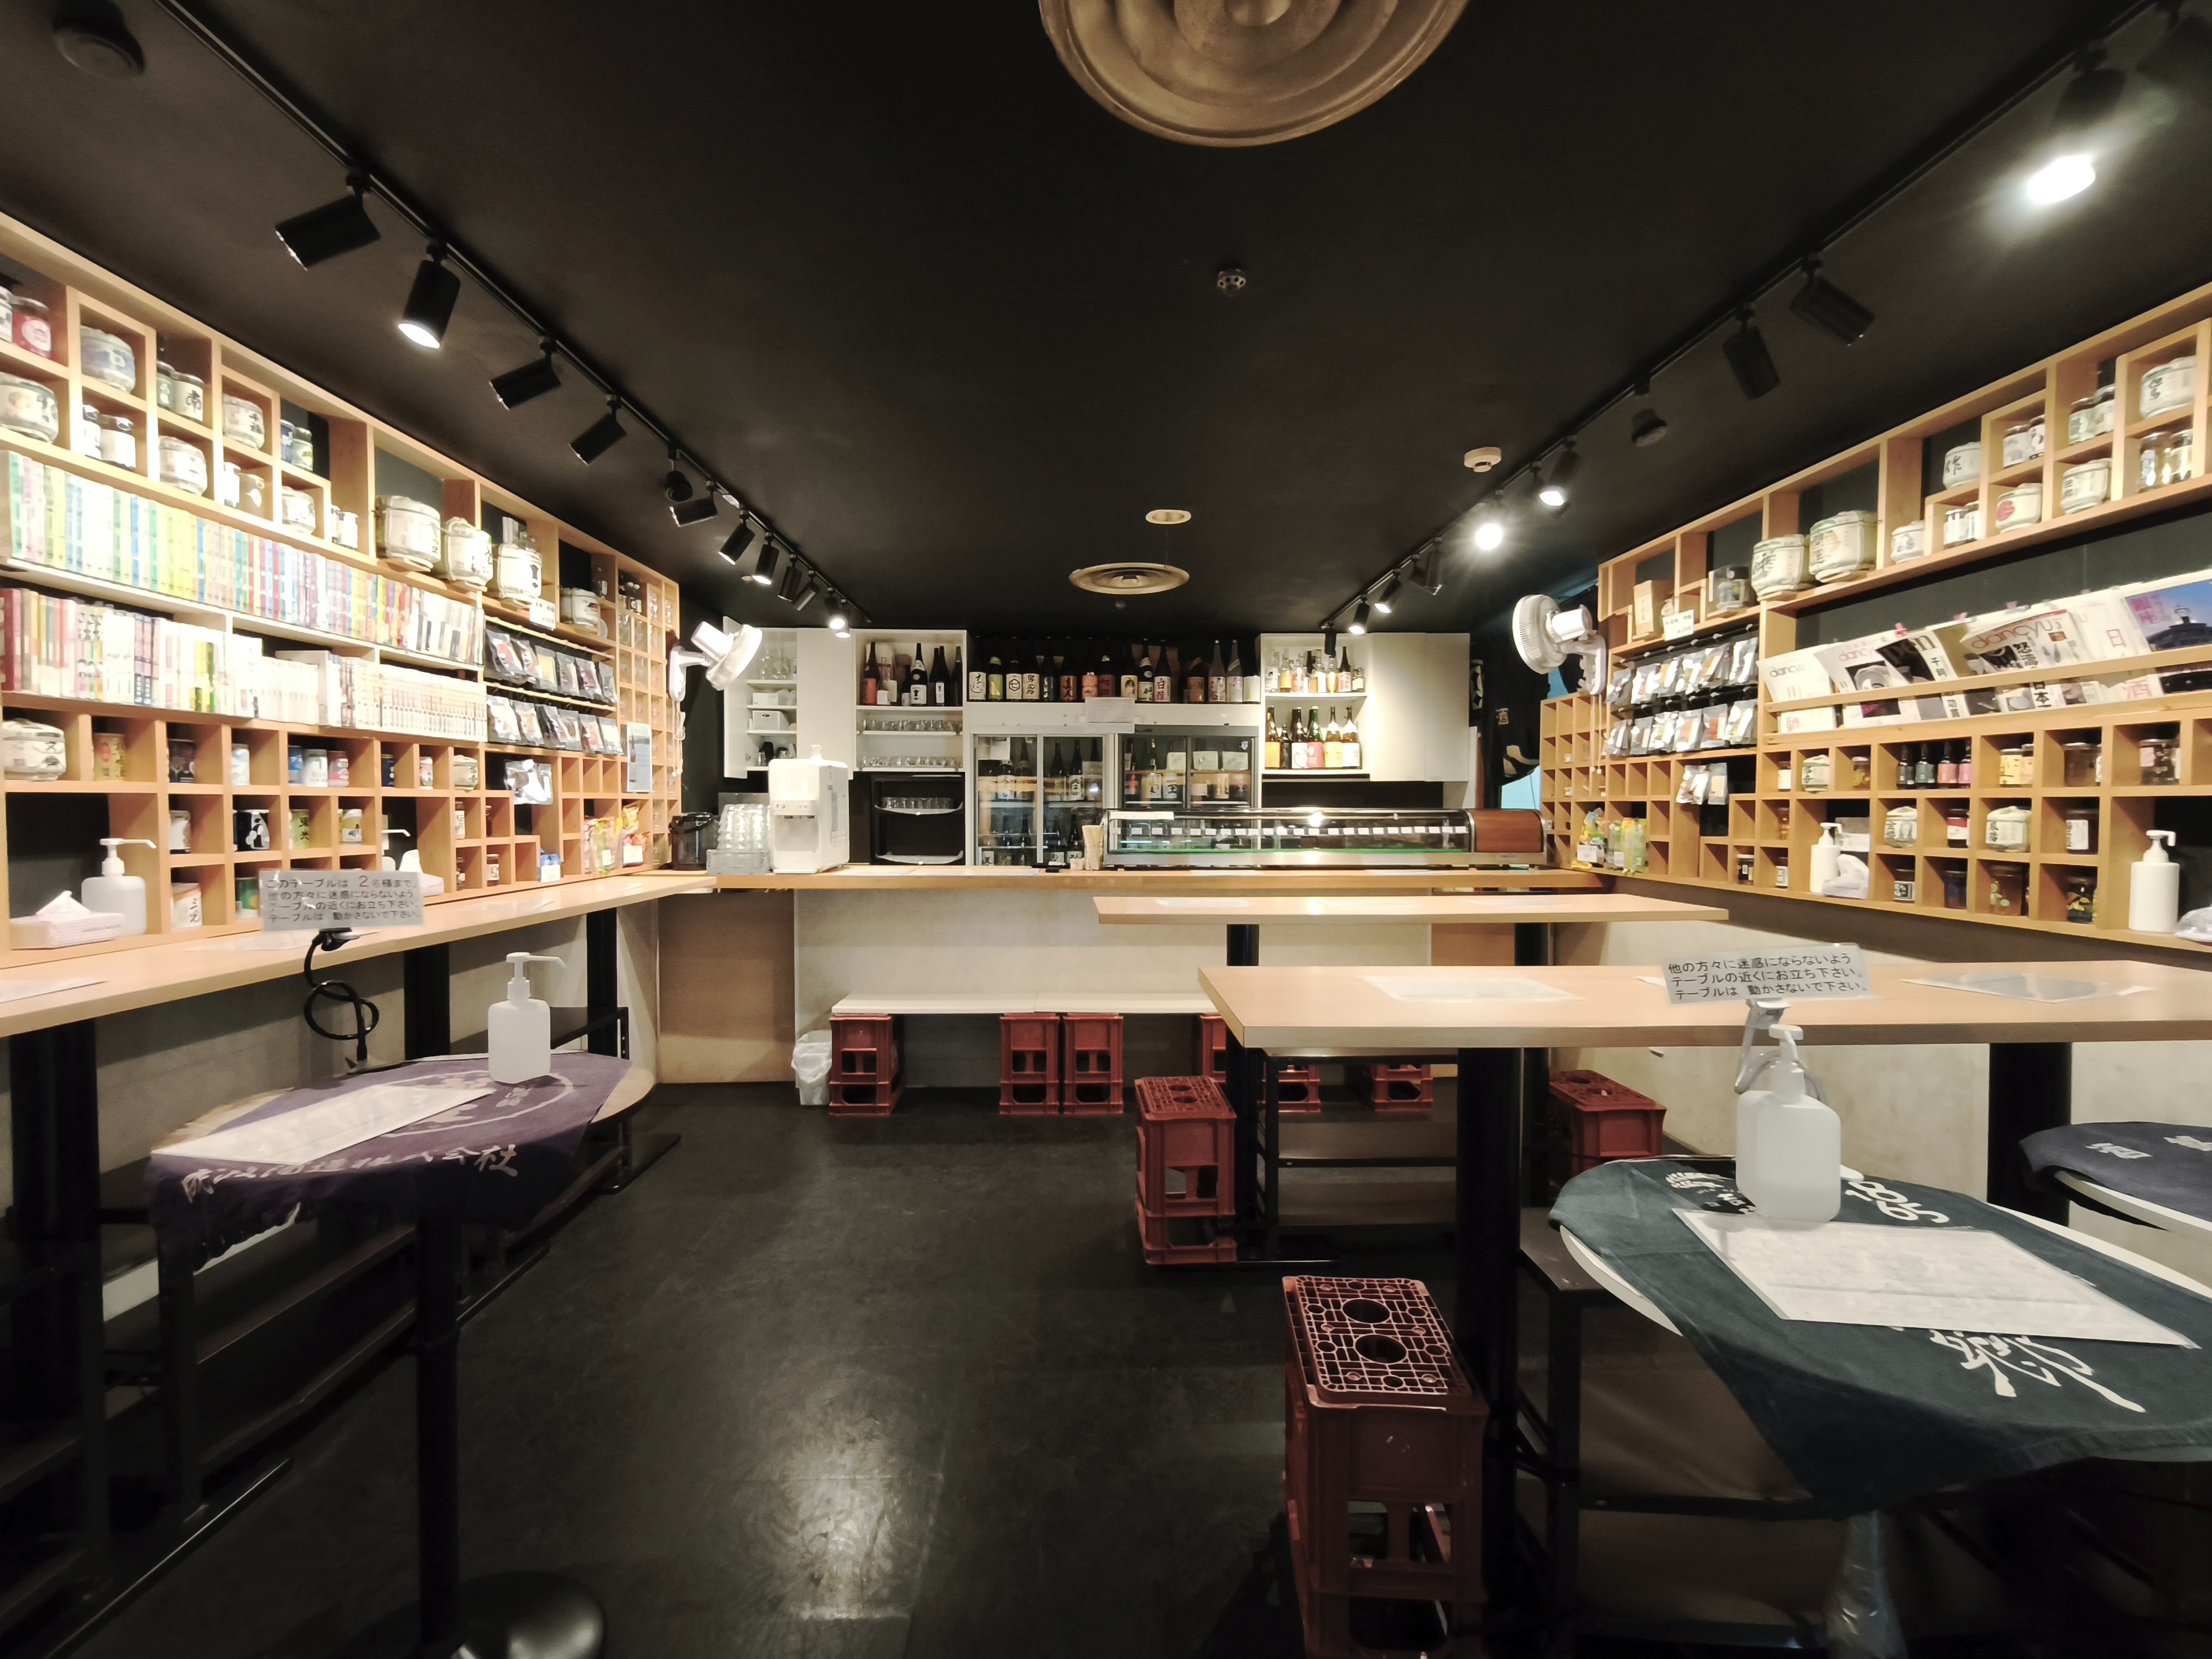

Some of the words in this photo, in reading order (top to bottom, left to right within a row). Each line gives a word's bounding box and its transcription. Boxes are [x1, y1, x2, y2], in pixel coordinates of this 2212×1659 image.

[1970, 620, 2053, 649] dancyu
[1769, 664, 1806, 677] dancyu
[268, 890, 414, 901] 他の方々に迷惑にならないよう
[269, 914, 324, 922] テーブルは
[1668, 953, 1851, 975] 他の方々に迷惑にならないよう
[1671, 967, 1864, 987] テーブルの近くにお立ち下さい。
[1674, 986, 1738, 1000] テーブルは
[1748, 981, 1868, 997] 動かさないで下さい。
